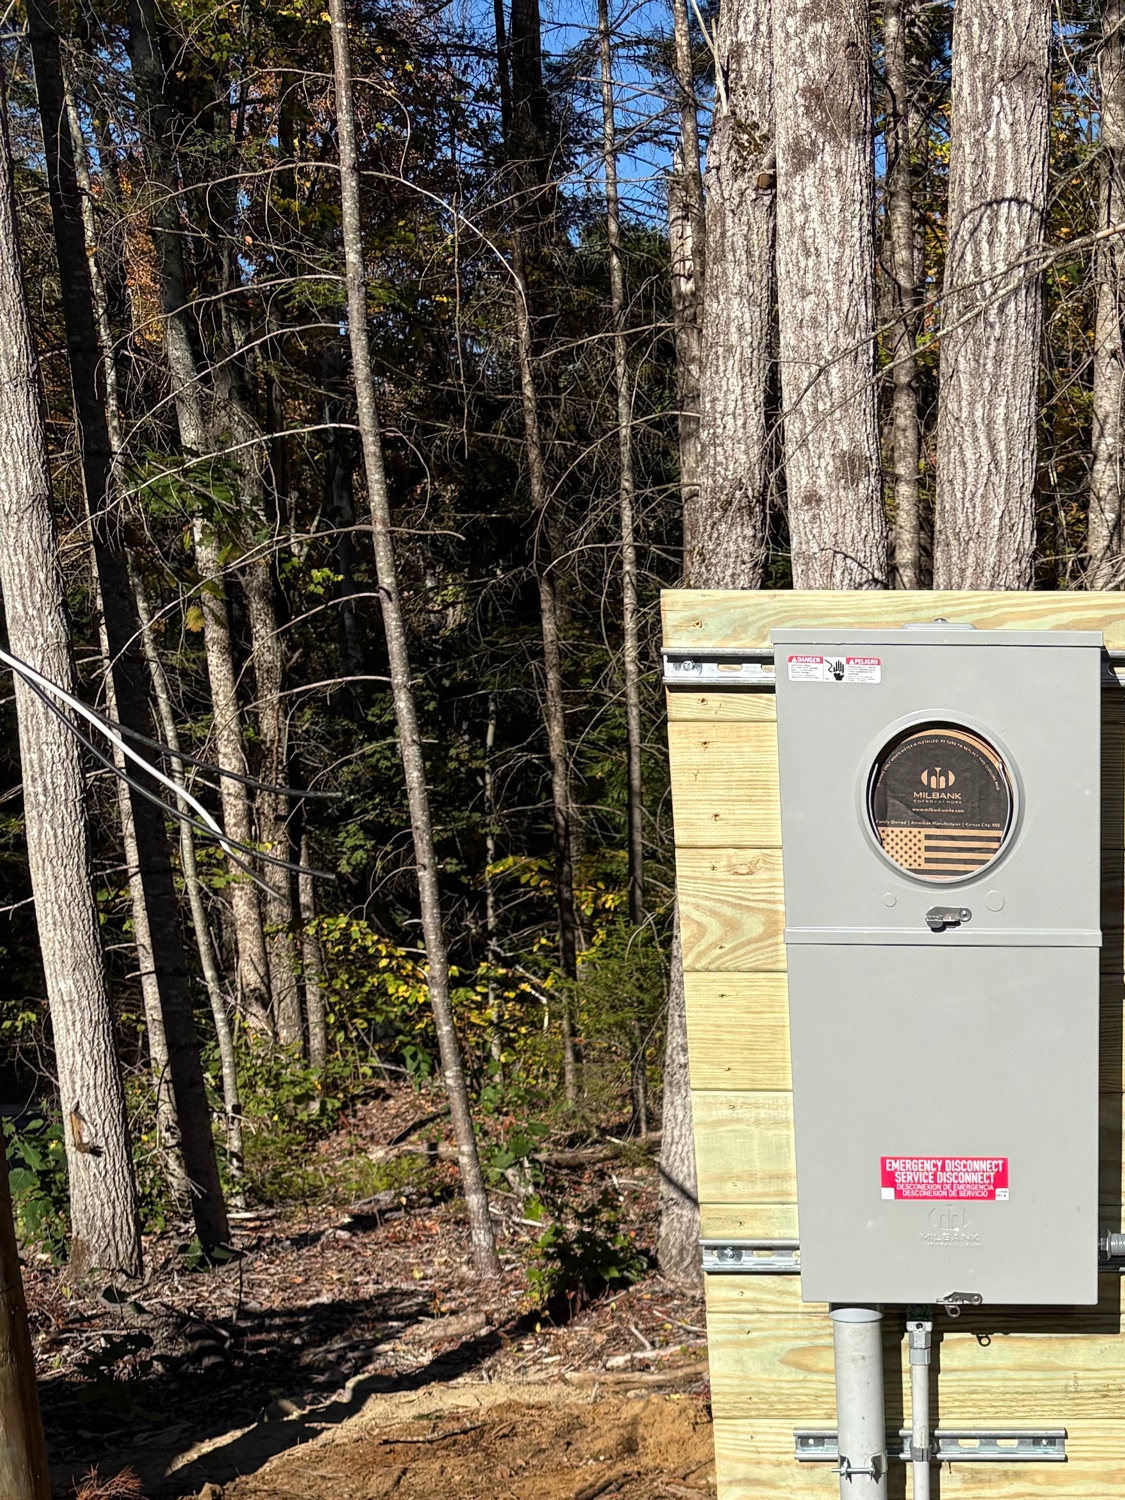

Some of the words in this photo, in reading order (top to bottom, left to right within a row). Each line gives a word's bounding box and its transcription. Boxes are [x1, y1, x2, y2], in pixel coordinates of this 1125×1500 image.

[913, 791, 962, 800] MILBANK
[885, 1159, 943, 1172] EMERGENCY
[945, 1160, 1004, 1172] DISCONNECT
[895, 1171, 934, 1183] SERVICE
[937, 1172, 995, 1184] DISCONNECT
[920, 1232, 980, 1242] MILBANK
